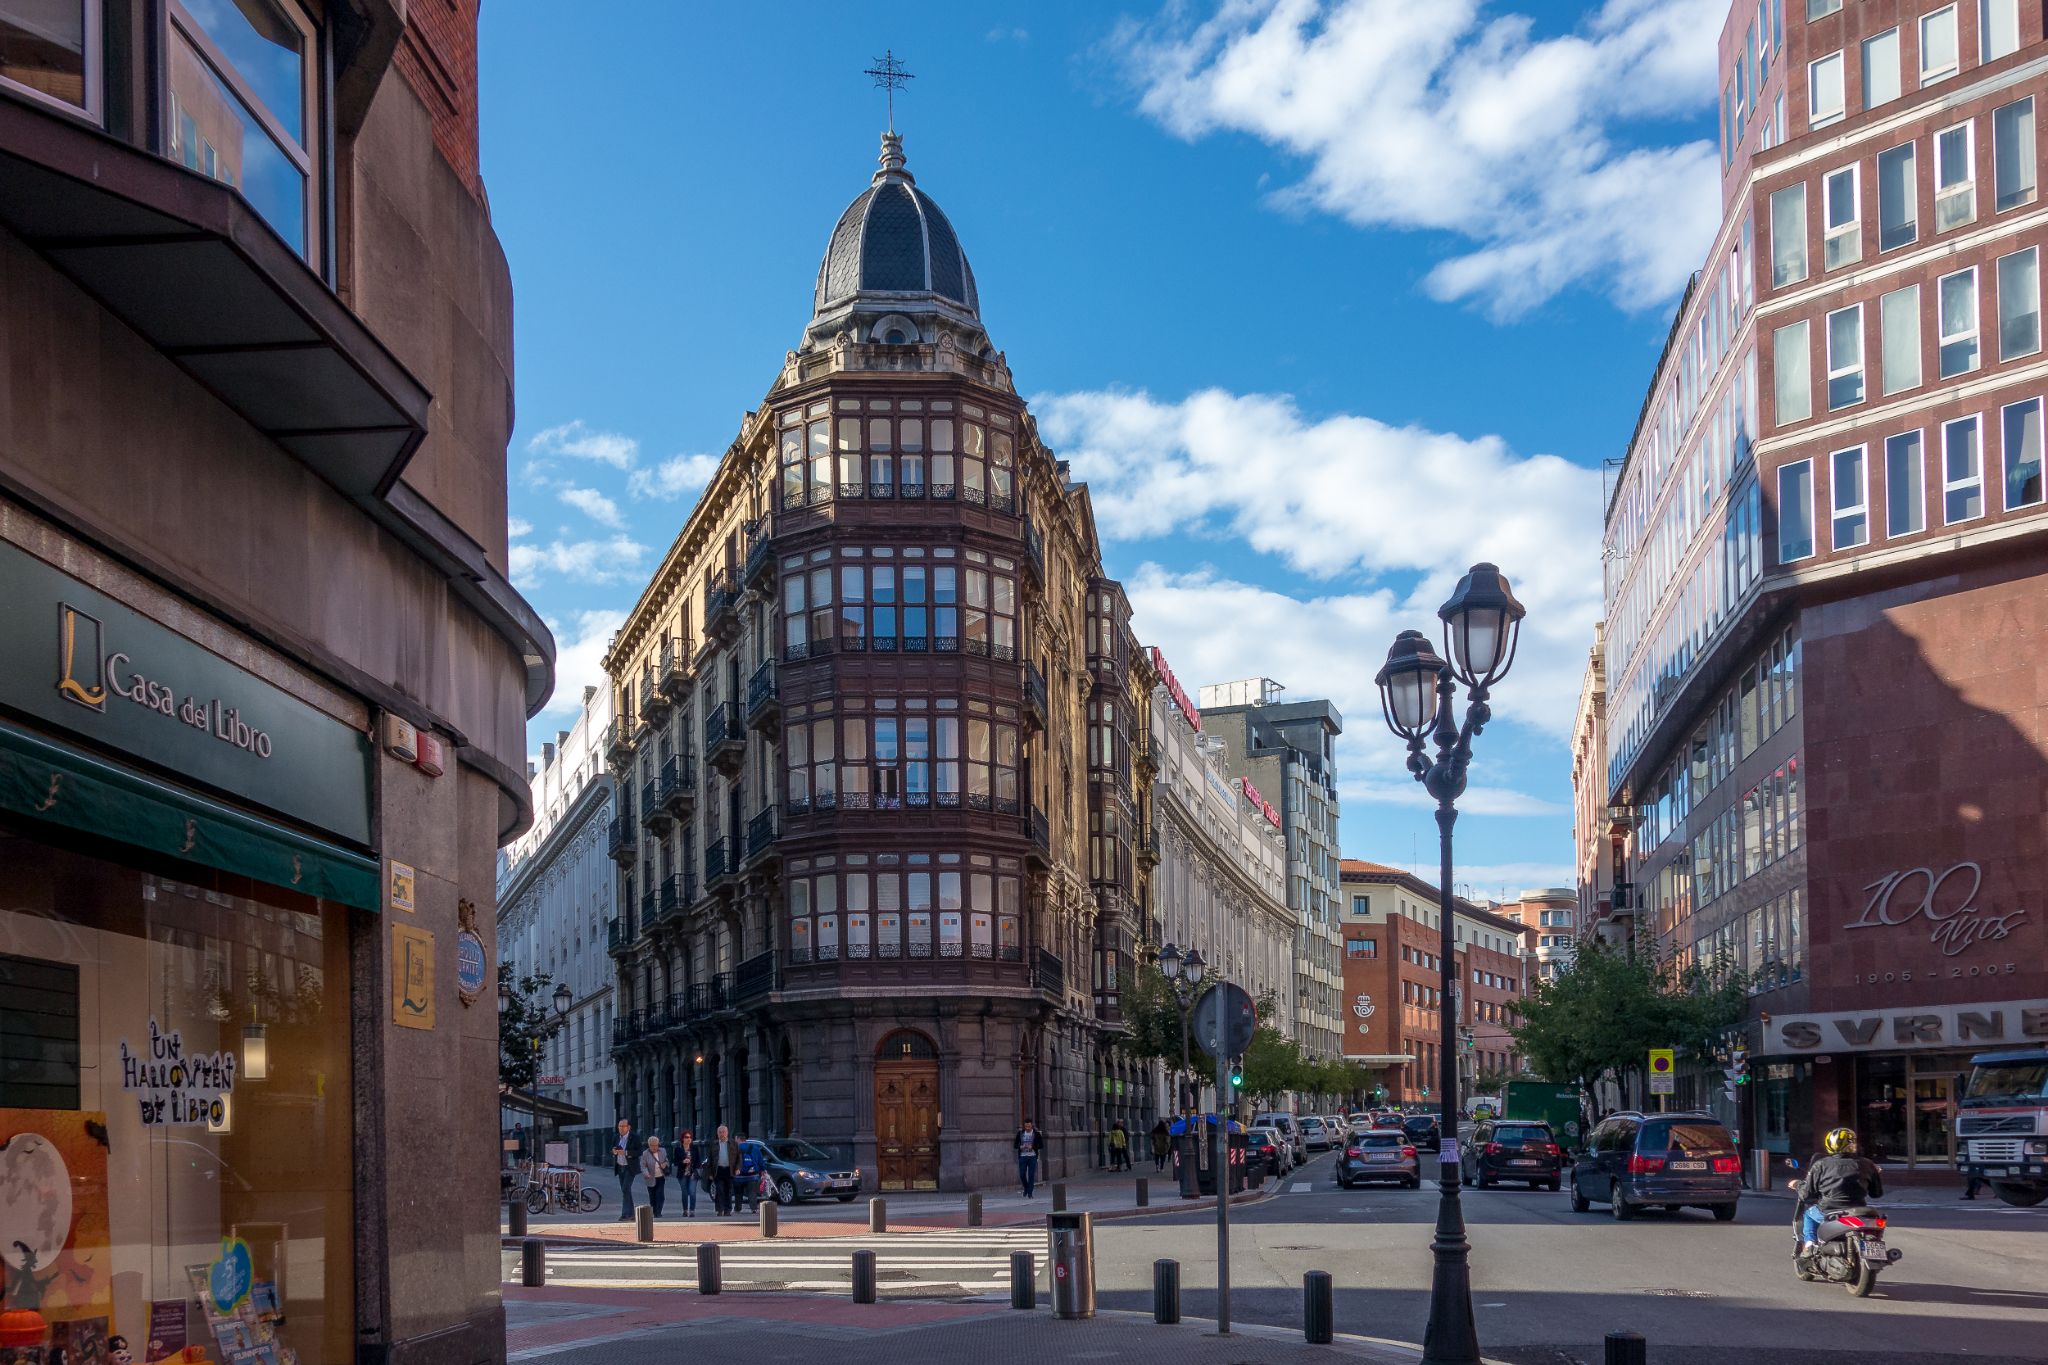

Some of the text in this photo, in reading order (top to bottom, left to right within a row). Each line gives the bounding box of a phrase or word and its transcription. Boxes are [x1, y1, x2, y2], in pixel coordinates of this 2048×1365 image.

[106, 652, 272, 758] Casa del Libro
[1843, 862, 2027, 956] 100 años
[1855, 972, 1912, 985] 1905
[1952, 963, 2016, 978] 2005
[121, 1043, 233, 1089] HALLOWEEN
[902, 1043, 911, 1053] 11
[139, 1095, 165, 1124] DE
